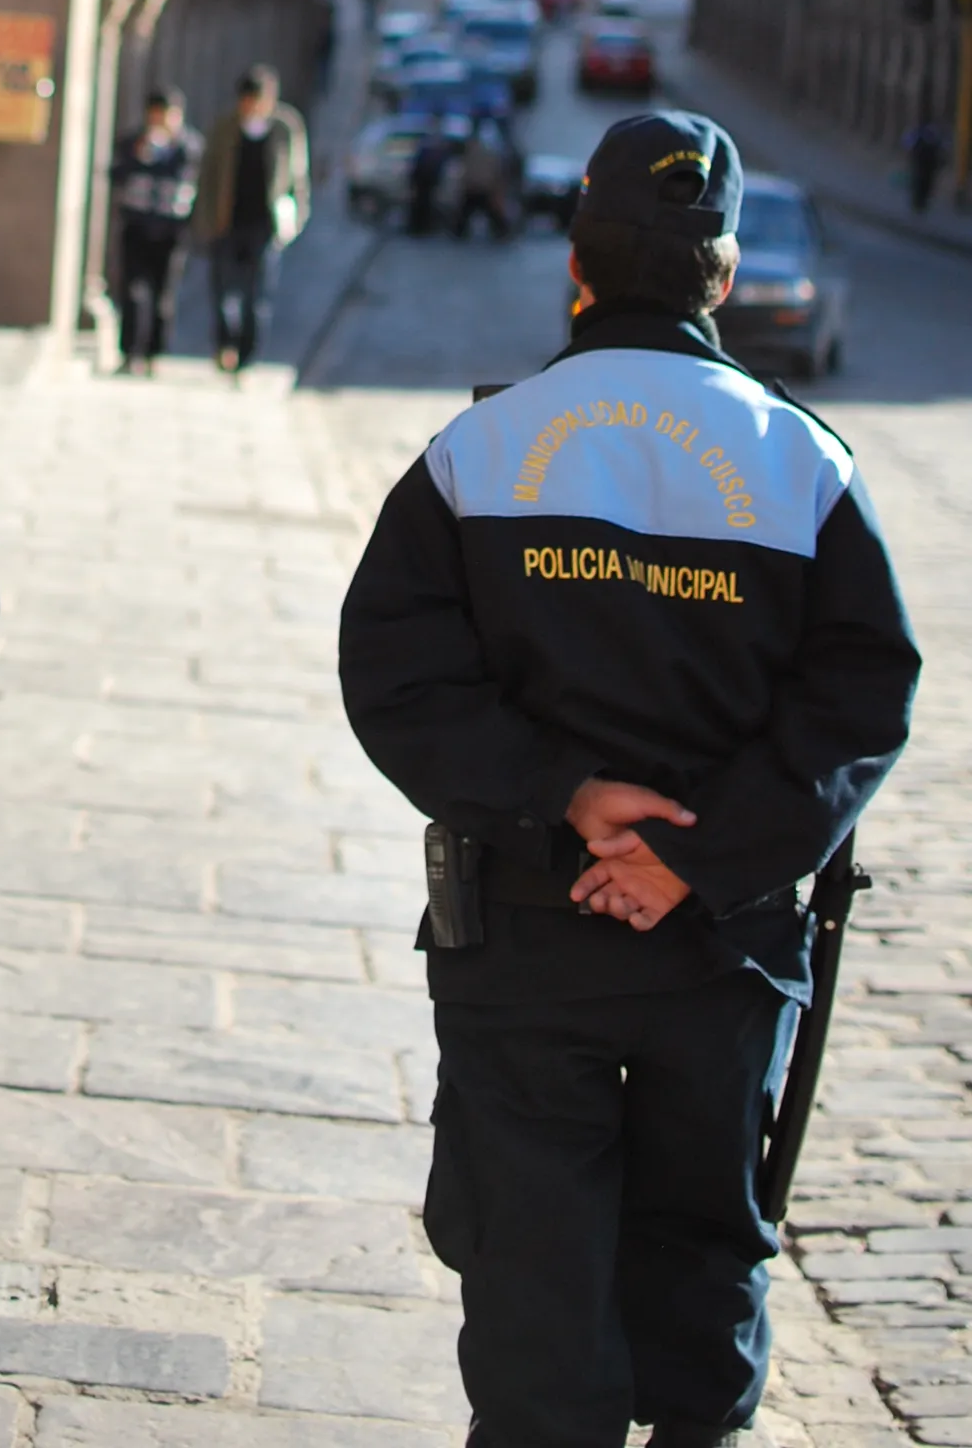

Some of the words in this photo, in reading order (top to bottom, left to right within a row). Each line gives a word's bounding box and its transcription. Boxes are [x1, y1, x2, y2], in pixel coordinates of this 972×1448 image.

[513, 400, 647, 502] MUNICIPALIDAD
[655, 411, 700, 452] DEL
[700, 447, 756, 528] CUSCO
[524, 546, 622, 580] POLICIA
